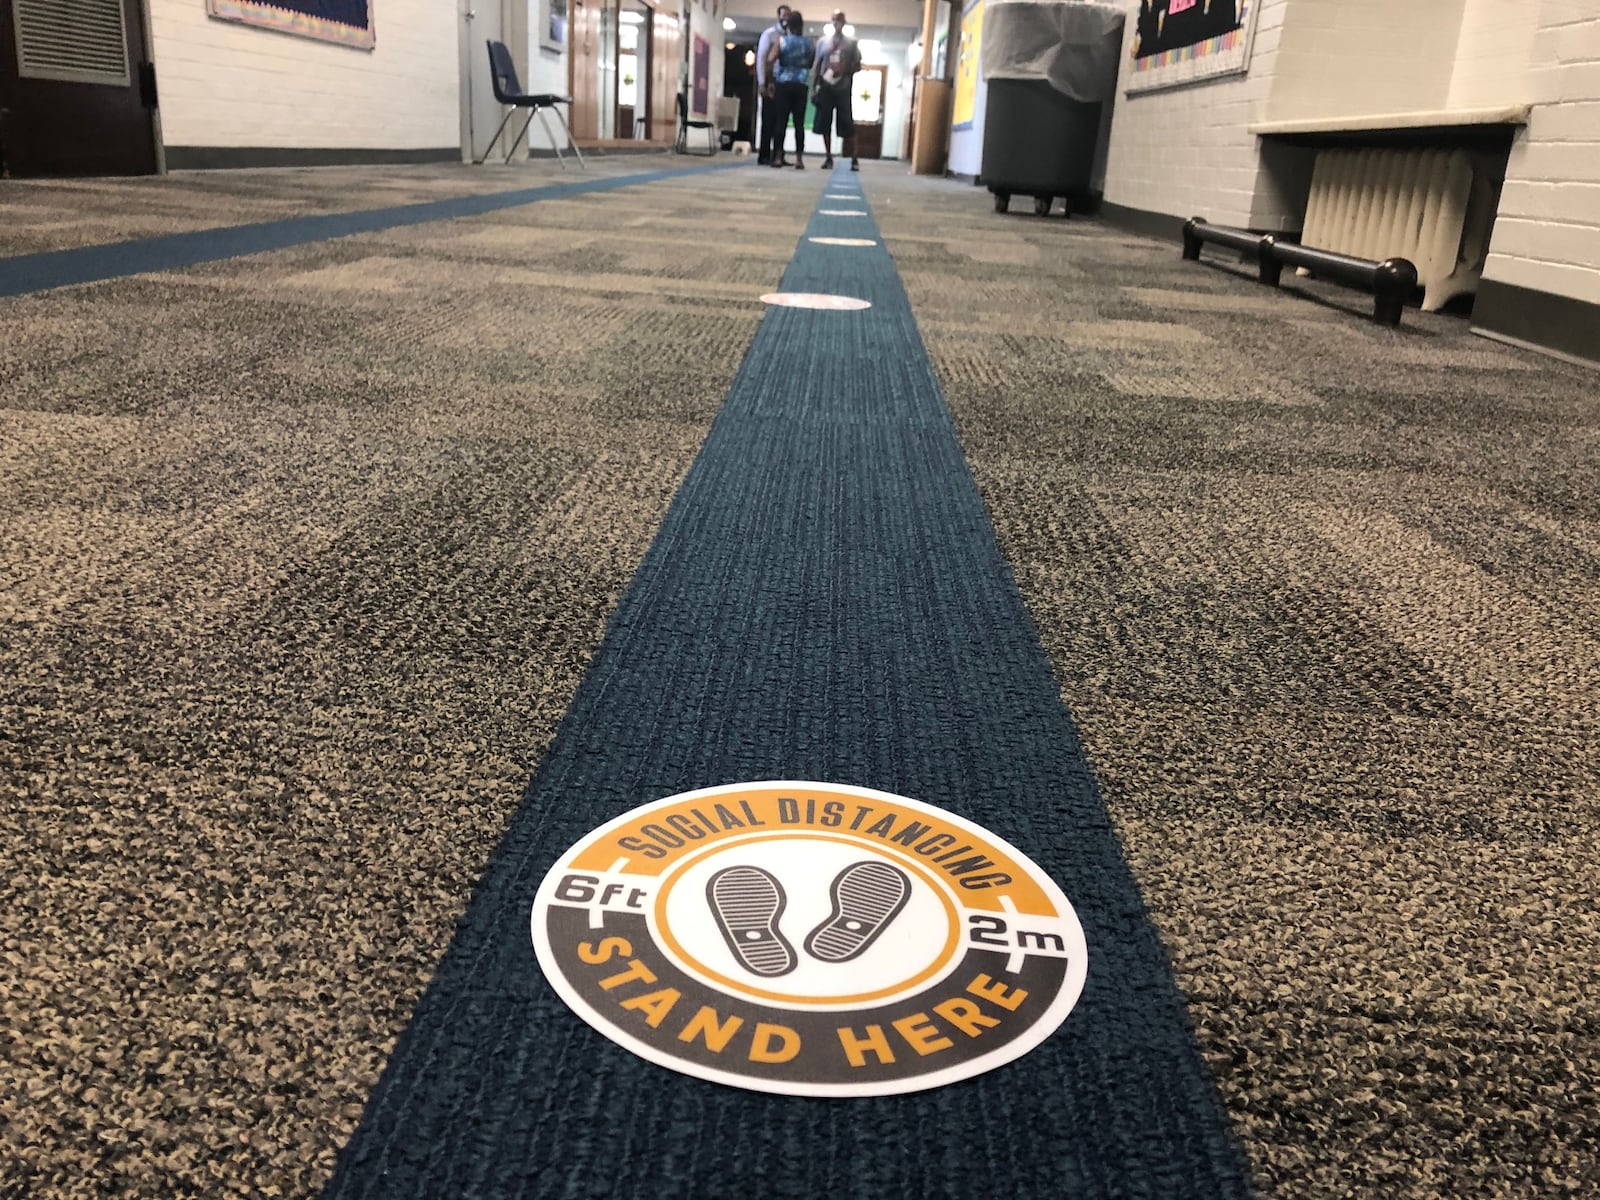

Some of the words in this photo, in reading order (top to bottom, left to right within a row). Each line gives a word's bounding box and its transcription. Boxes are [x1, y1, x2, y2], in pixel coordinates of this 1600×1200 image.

[617, 799, 765, 860] SOCIAL
[777, 797, 1012, 891] DISTANCING
[554, 874, 647, 908] 6ft
[968, 914, 1065, 952] 2m
[577, 936, 801, 1064] STAND
[836, 972, 1029, 1067] HERE
